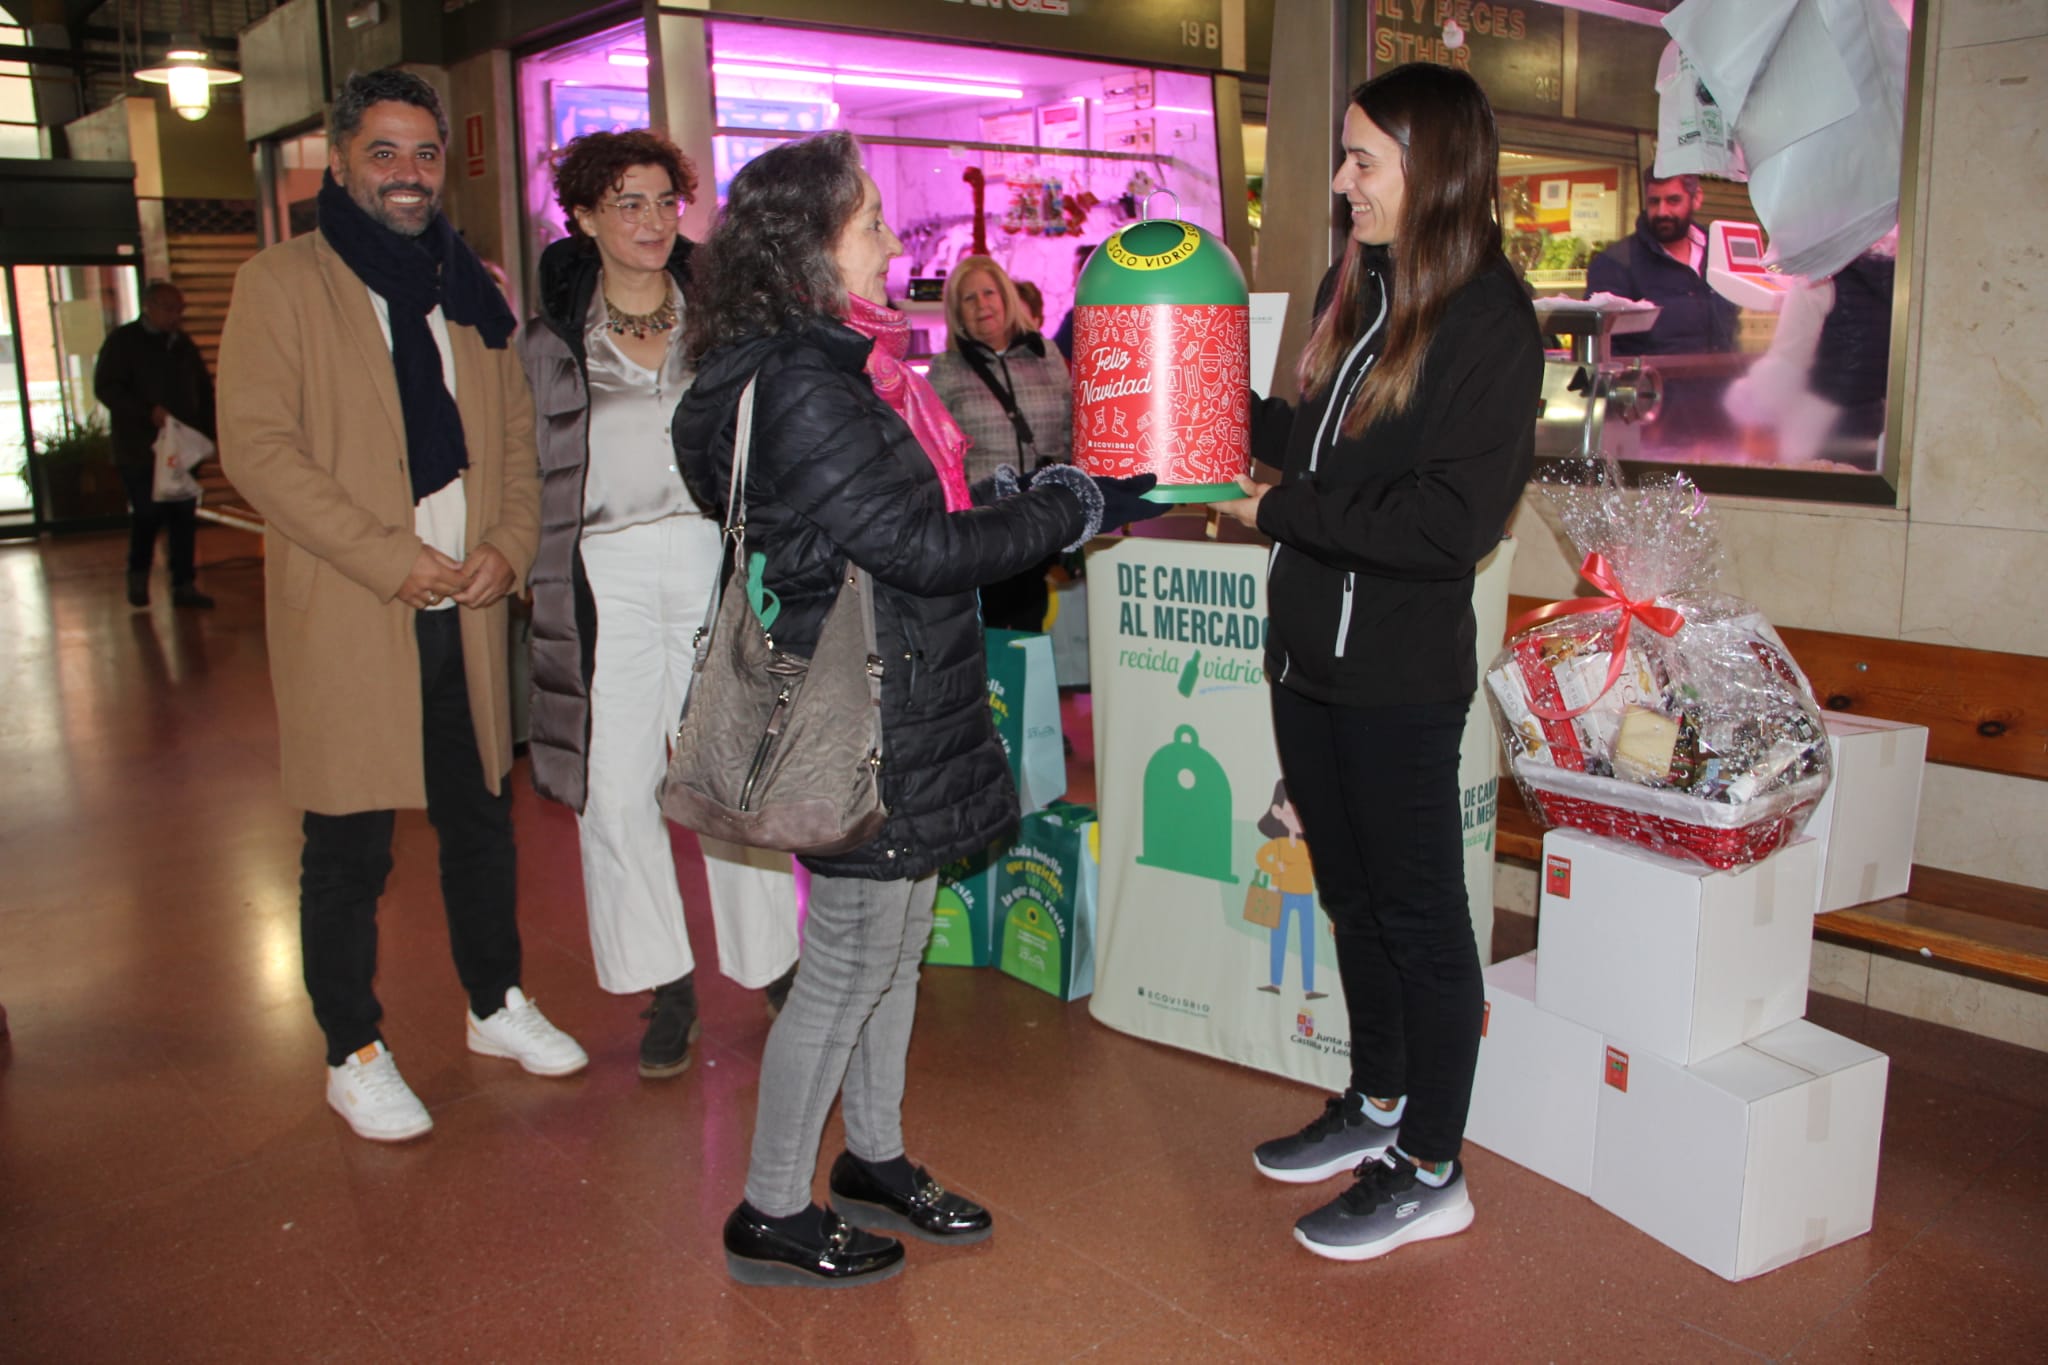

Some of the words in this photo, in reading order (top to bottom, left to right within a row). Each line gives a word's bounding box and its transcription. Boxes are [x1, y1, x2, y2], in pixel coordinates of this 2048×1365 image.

[1180, 20, 1200, 47] 19
[1205, 23, 1218, 49] B
[1433, 0, 1526, 40] PECES
[1375, 27, 1472, 72] STHER
[1109, 243, 1138, 267] SOLO
[1145, 242, 1194, 267] VIDRIO
[1091, 346, 1131, 376] Feliz
[1080, 371, 1152, 406] Navidad
[1117, 562, 1148, 598] DE
[1153, 565, 1256, 609] CAMINO
[1119, 601, 1148, 637] AL
[1119, 646, 1179, 675] recicla
[1203, 656, 1263, 685] vidrio
[1464, 786, 1476, 808] DE
[1463, 808, 1475, 831] AL
[1290, 1034, 1322, 1051] Castilla
[1324, 1045, 1330, 1055] y
[1315, 1032, 1342, 1046] Junta
